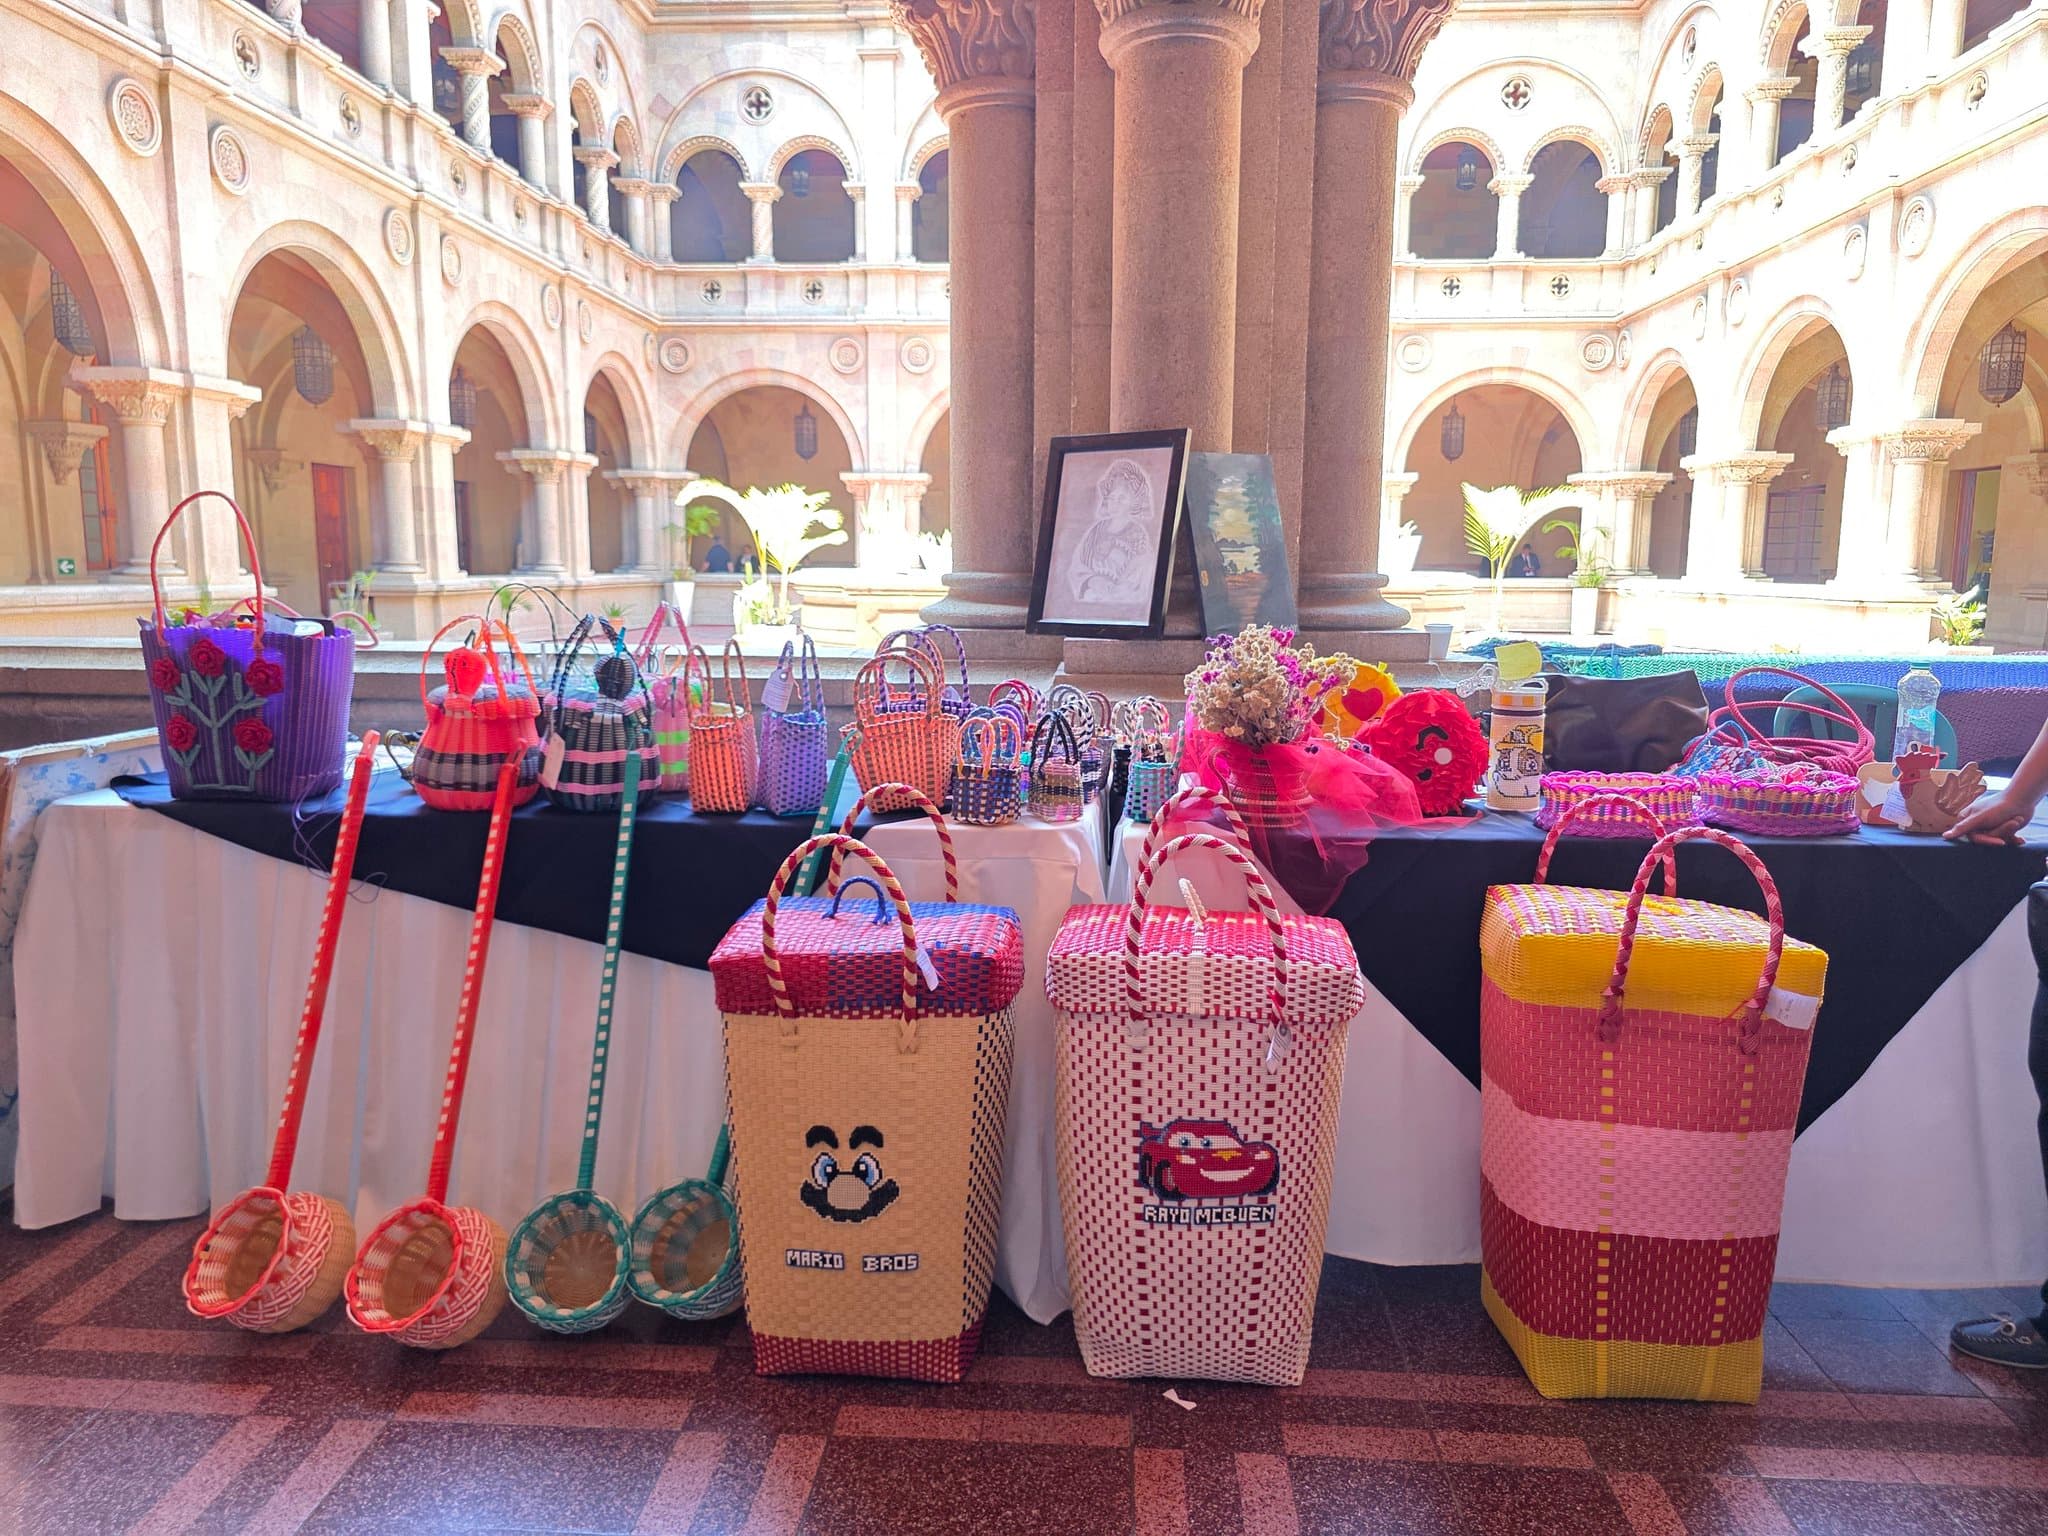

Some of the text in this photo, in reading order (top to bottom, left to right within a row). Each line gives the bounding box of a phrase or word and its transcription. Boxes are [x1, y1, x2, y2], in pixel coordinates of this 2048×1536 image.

[1144, 1206, 1275, 1224] RAYO MCQUEN
[786, 1250, 918, 1271] MARIO BROS
